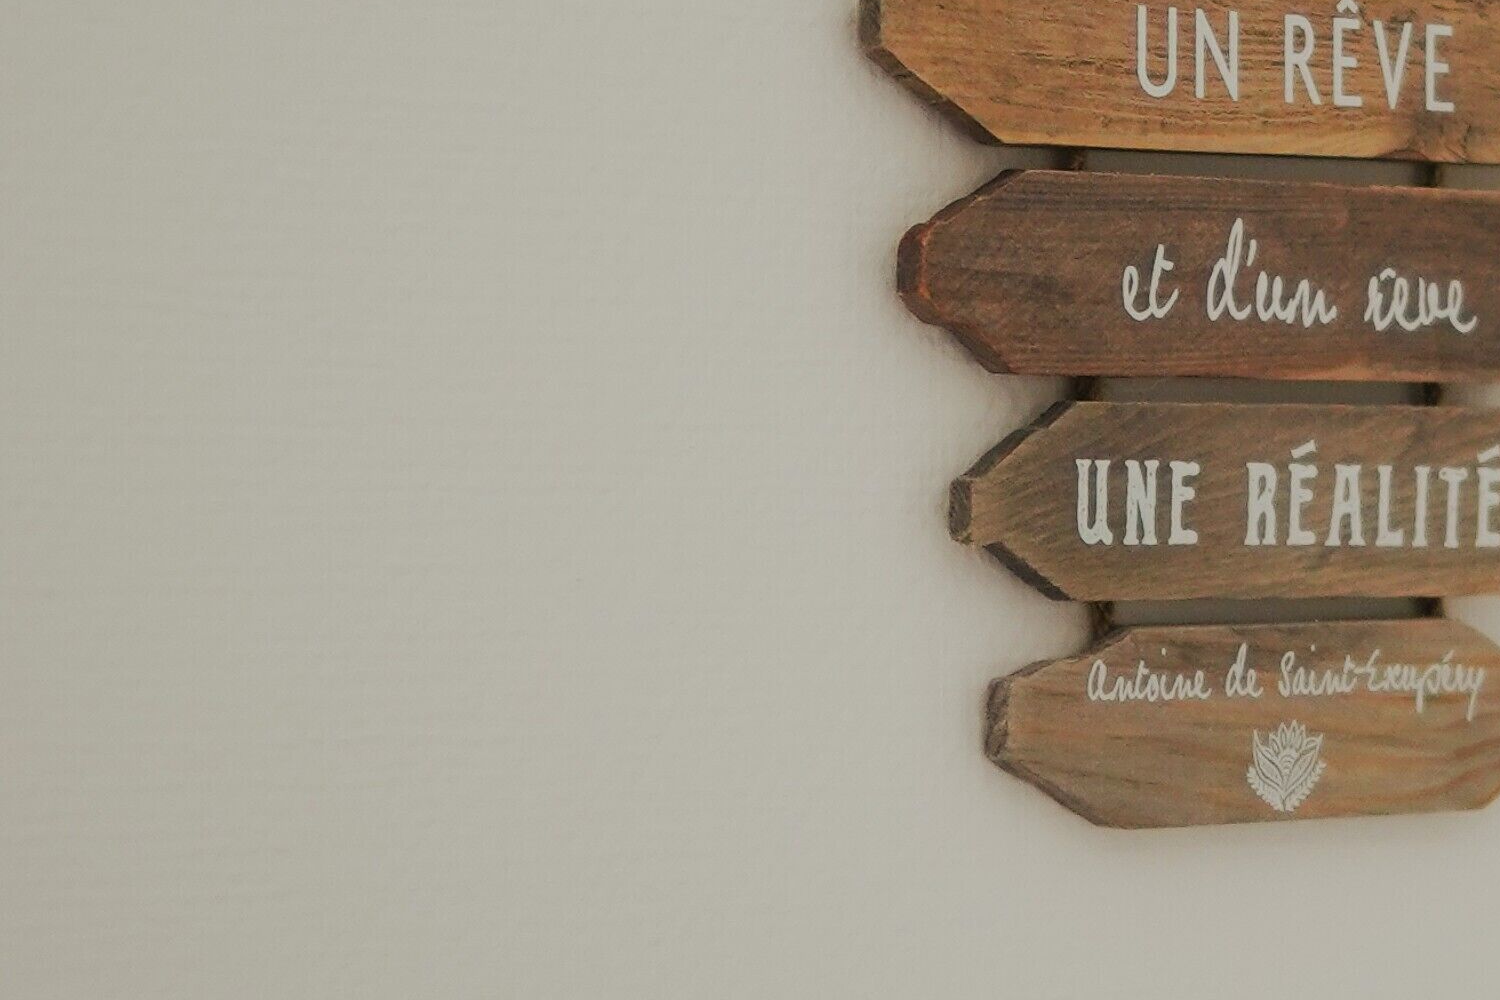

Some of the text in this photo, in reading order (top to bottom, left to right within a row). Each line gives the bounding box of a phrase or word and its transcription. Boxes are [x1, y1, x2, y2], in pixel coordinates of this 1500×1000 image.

[1136, 4, 1239, 101] UN
[1122, 243, 1179, 322] et
[1206, 217, 1337, 328] d'un
[1075, 458, 1200, 546] UNE
[1087, 647, 1213, 703] Antoine
[1225, 643, 1263, 698] de
